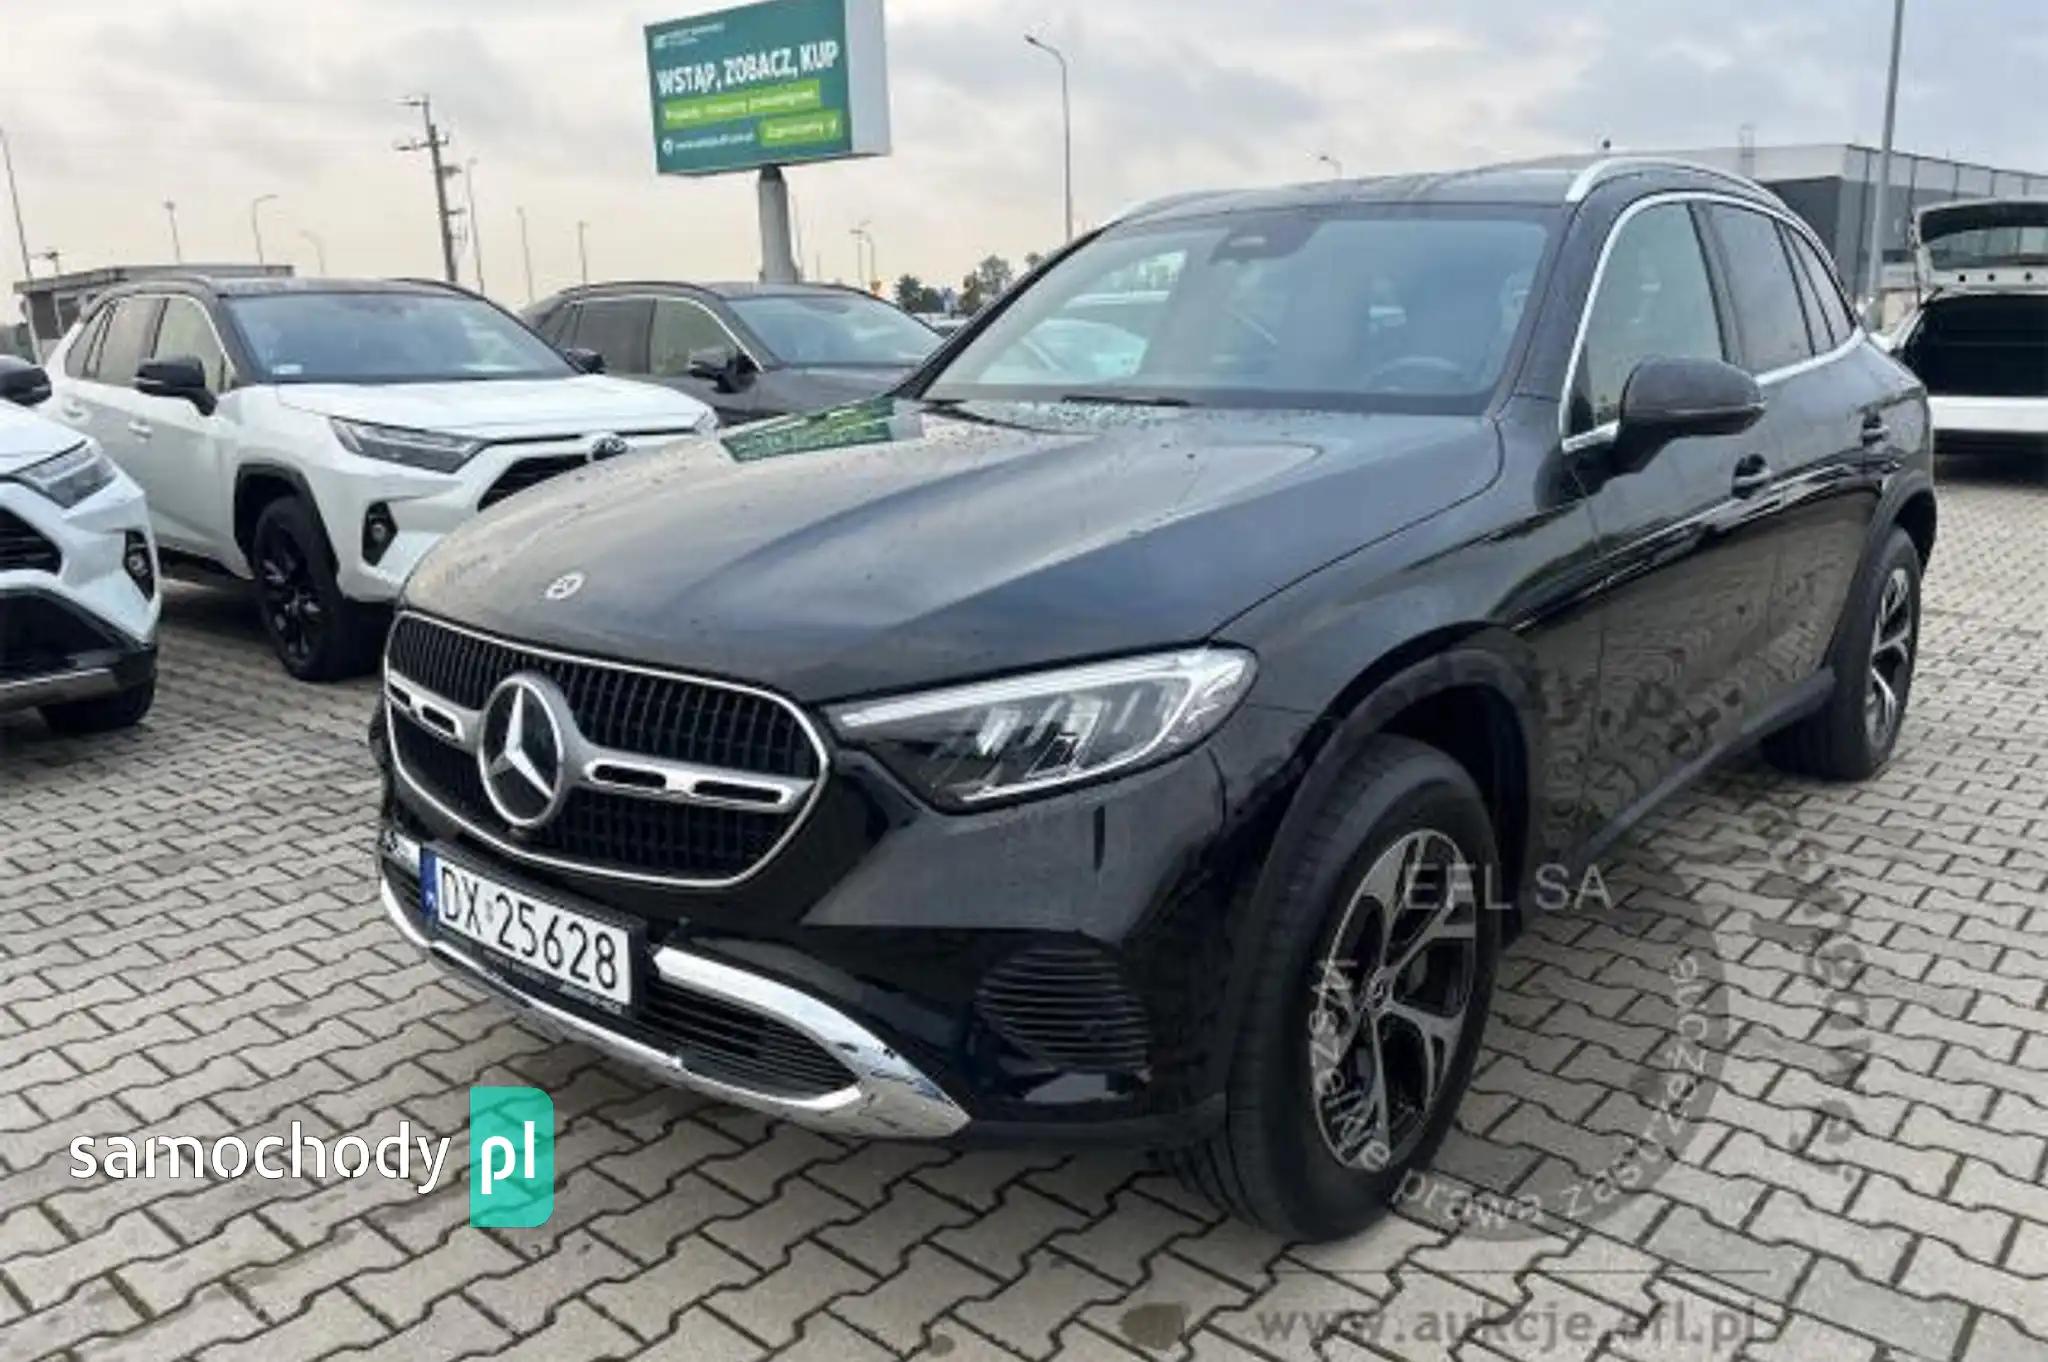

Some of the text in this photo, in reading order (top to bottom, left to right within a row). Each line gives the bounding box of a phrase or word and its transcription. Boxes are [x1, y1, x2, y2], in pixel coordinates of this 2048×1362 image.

[799, 40, 839, 73] KUP
[441, 866, 481, 936] DX
[496, 892, 618, 990] 25628
